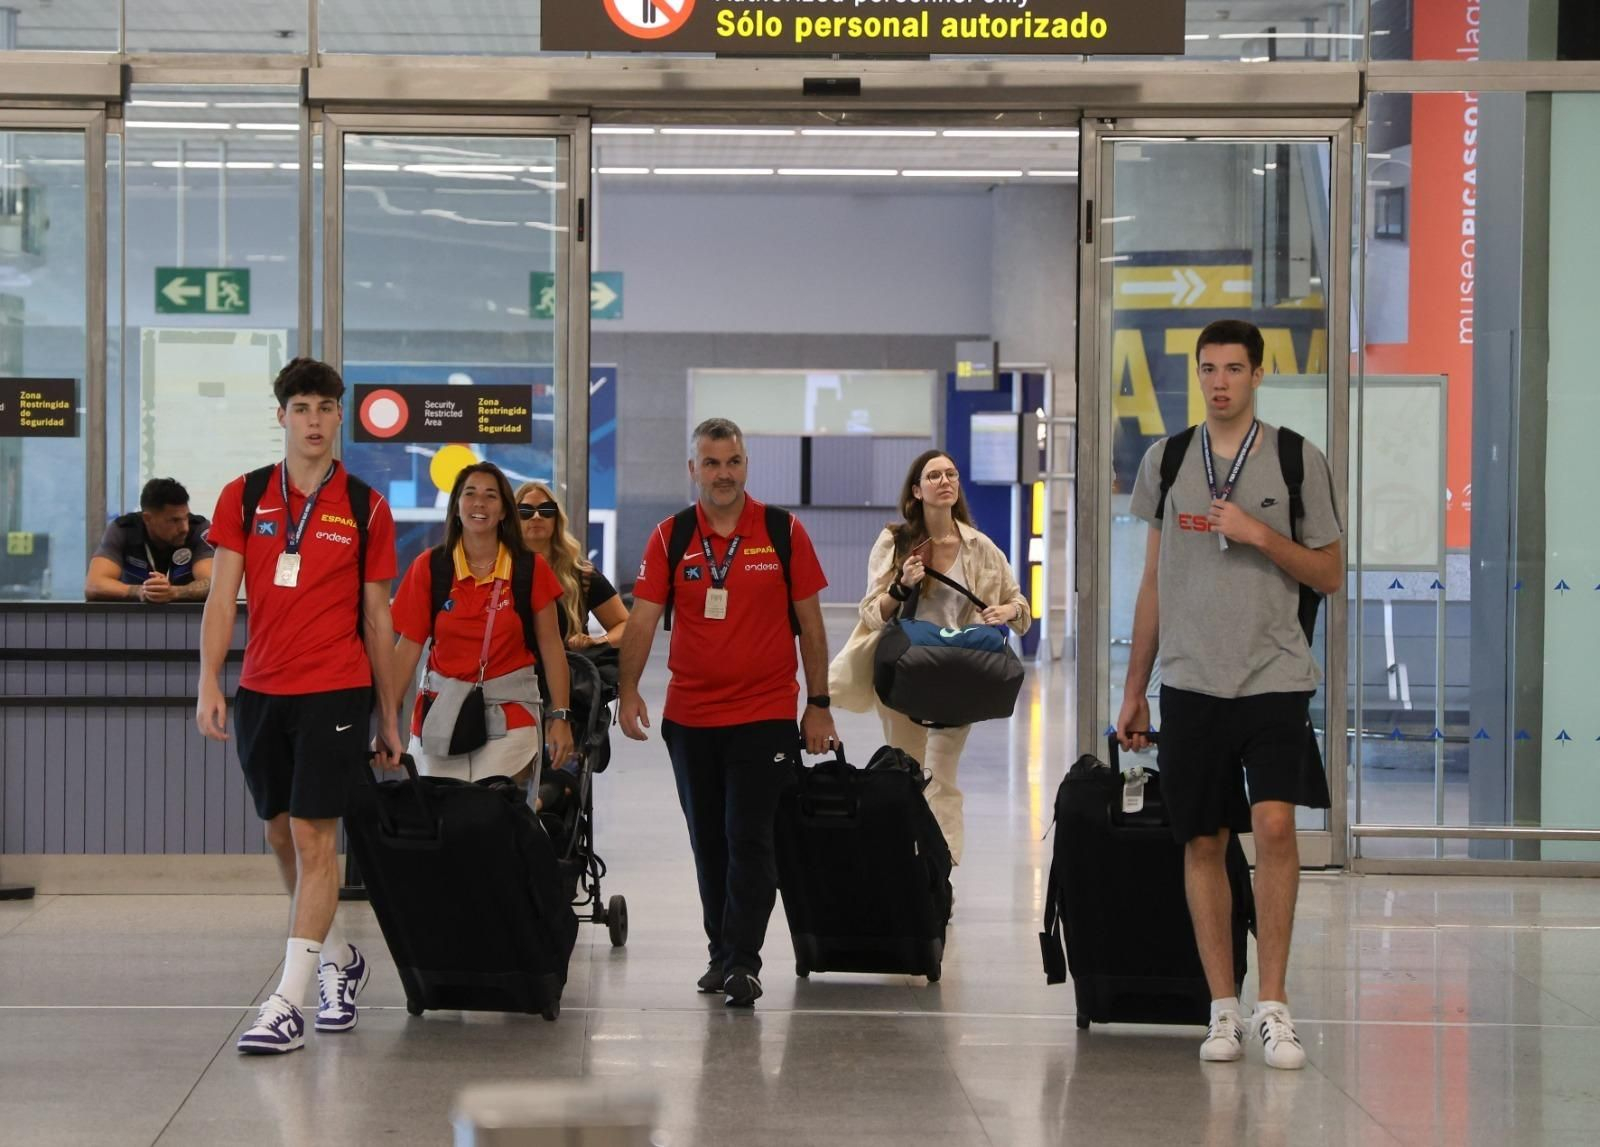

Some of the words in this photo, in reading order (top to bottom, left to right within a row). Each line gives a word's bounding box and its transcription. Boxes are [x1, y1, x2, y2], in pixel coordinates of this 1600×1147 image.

[716, 9, 782, 37] Sólo
[795, 11, 928, 43] personal
[941, 12, 1107, 39] autorizado
[20, 391, 41, 399] Zona
[20, 400, 70, 410] Restringida
[425, 400, 455, 410] Security
[478, 397, 499, 406] Zona
[20, 409, 31, 417] de
[425, 409, 463, 417] Restricted
[478, 406, 527, 416] Restringida
[20, 418, 64, 427] Seguridad
[424, 418, 442, 426] Area
[478, 415, 489, 423] de
[478, 424, 522, 433] Seguridad
[1179, 513, 1212, 532] ES
[744, 562, 779, 571] endesa
